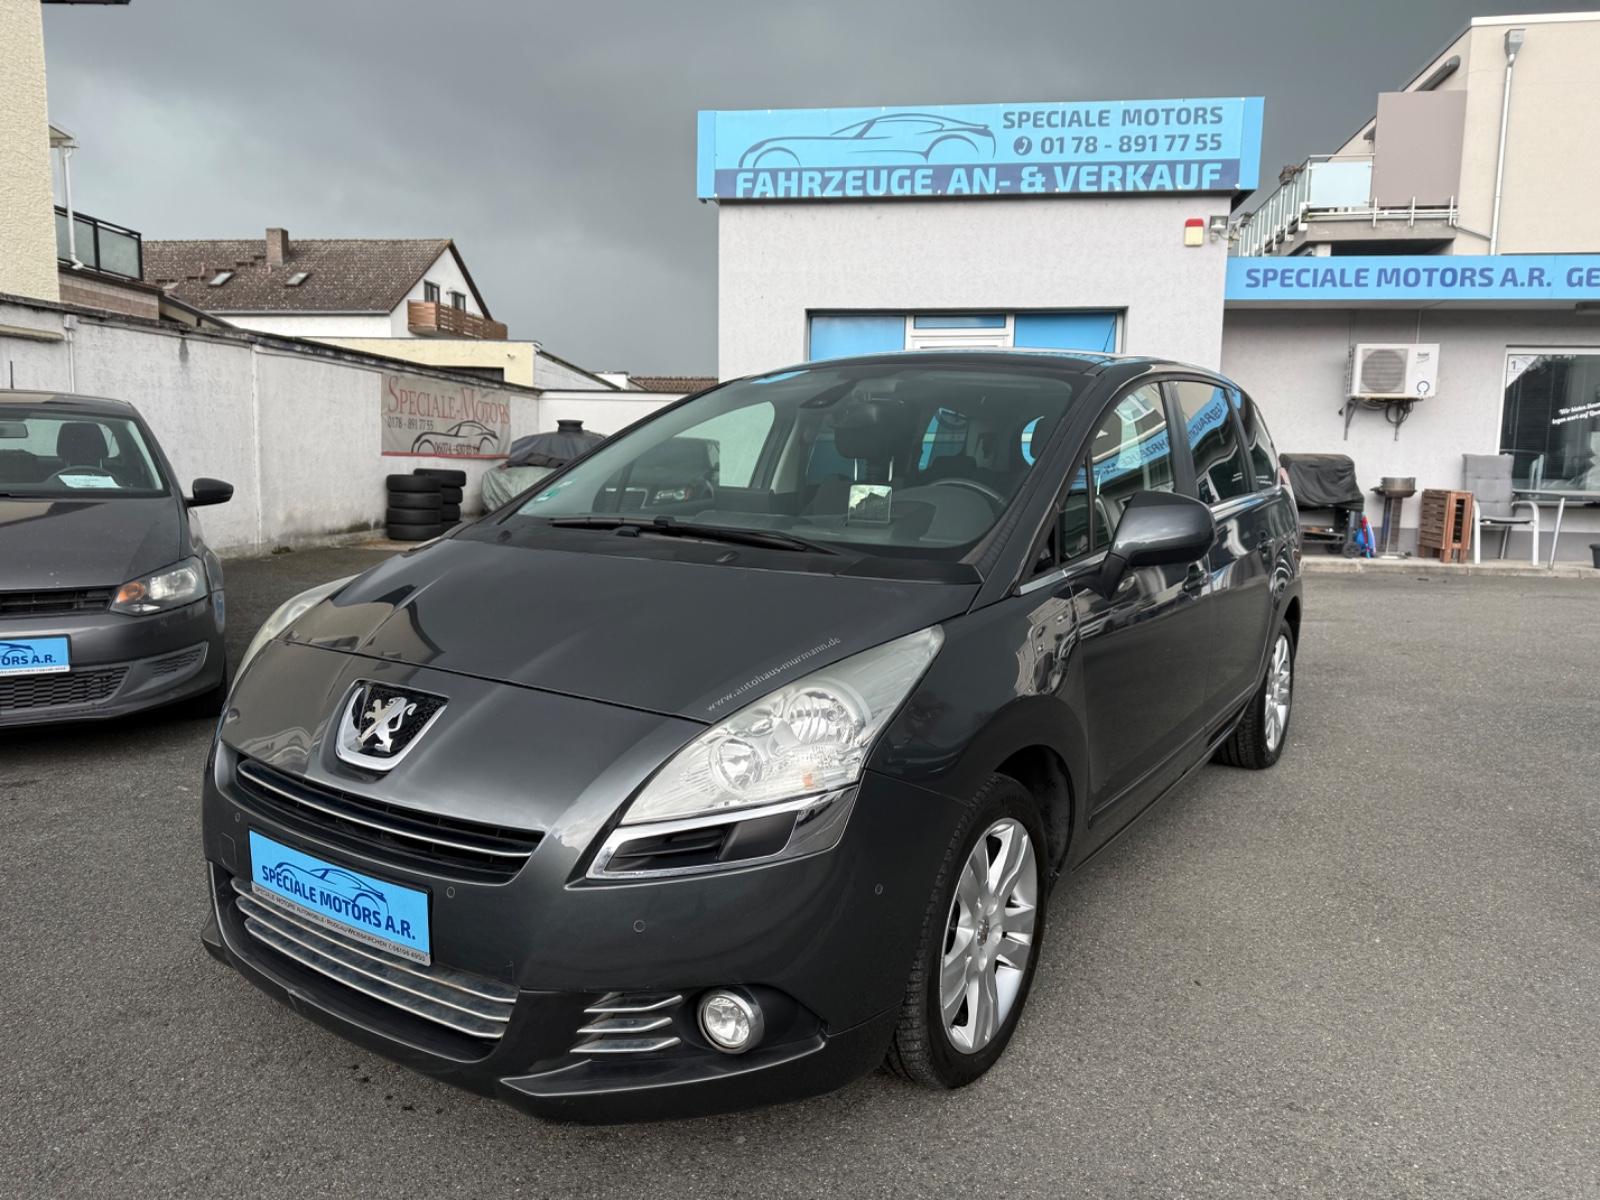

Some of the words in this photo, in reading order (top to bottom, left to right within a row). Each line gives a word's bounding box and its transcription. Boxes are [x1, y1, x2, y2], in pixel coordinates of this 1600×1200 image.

[1003, 110, 1111, 129] SPECIALE
[1121, 106, 1223, 126] MOTORS
[735, 168, 934, 198] FAHRZEUGE
[947, 167, 1010, 195] AN-
[1020, 166, 1046, 193] &
[1053, 163, 1222, 193] VERKAUF
[1245, 267, 1370, 288] SPECIALE
[1376, 267, 1493, 288] MOTORS
[1500, 267, 1552, 287] A.R.
[0, 654, 28, 666] ORS
[31, 654, 56, 664] A.R.
[261, 864, 317, 904] SPECIALE
[319, 890, 382, 929] MOTORS
[385, 915, 416, 941] A.R.
